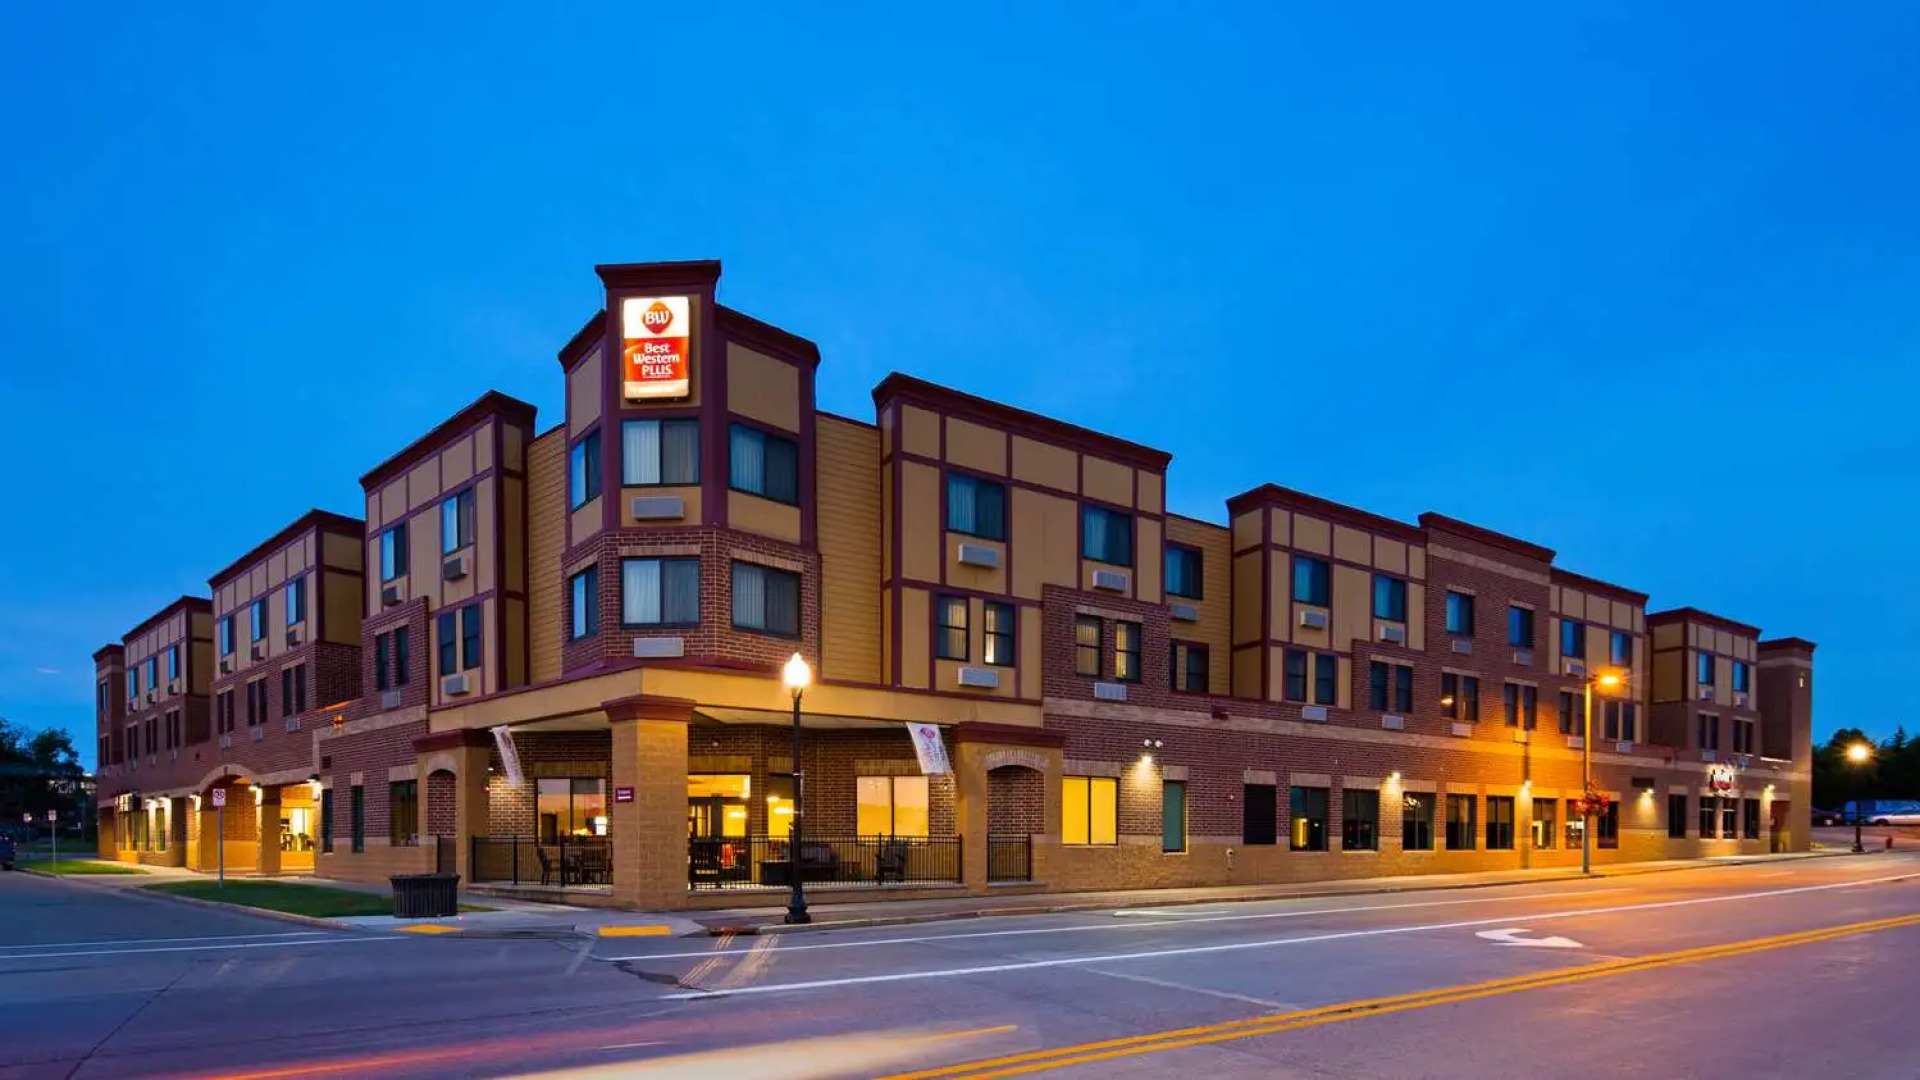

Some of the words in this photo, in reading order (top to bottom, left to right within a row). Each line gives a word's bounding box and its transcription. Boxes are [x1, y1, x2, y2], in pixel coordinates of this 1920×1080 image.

[645, 310, 670, 325] BW
[644, 342, 670, 353] Best
[633, 353, 680, 365] Western
